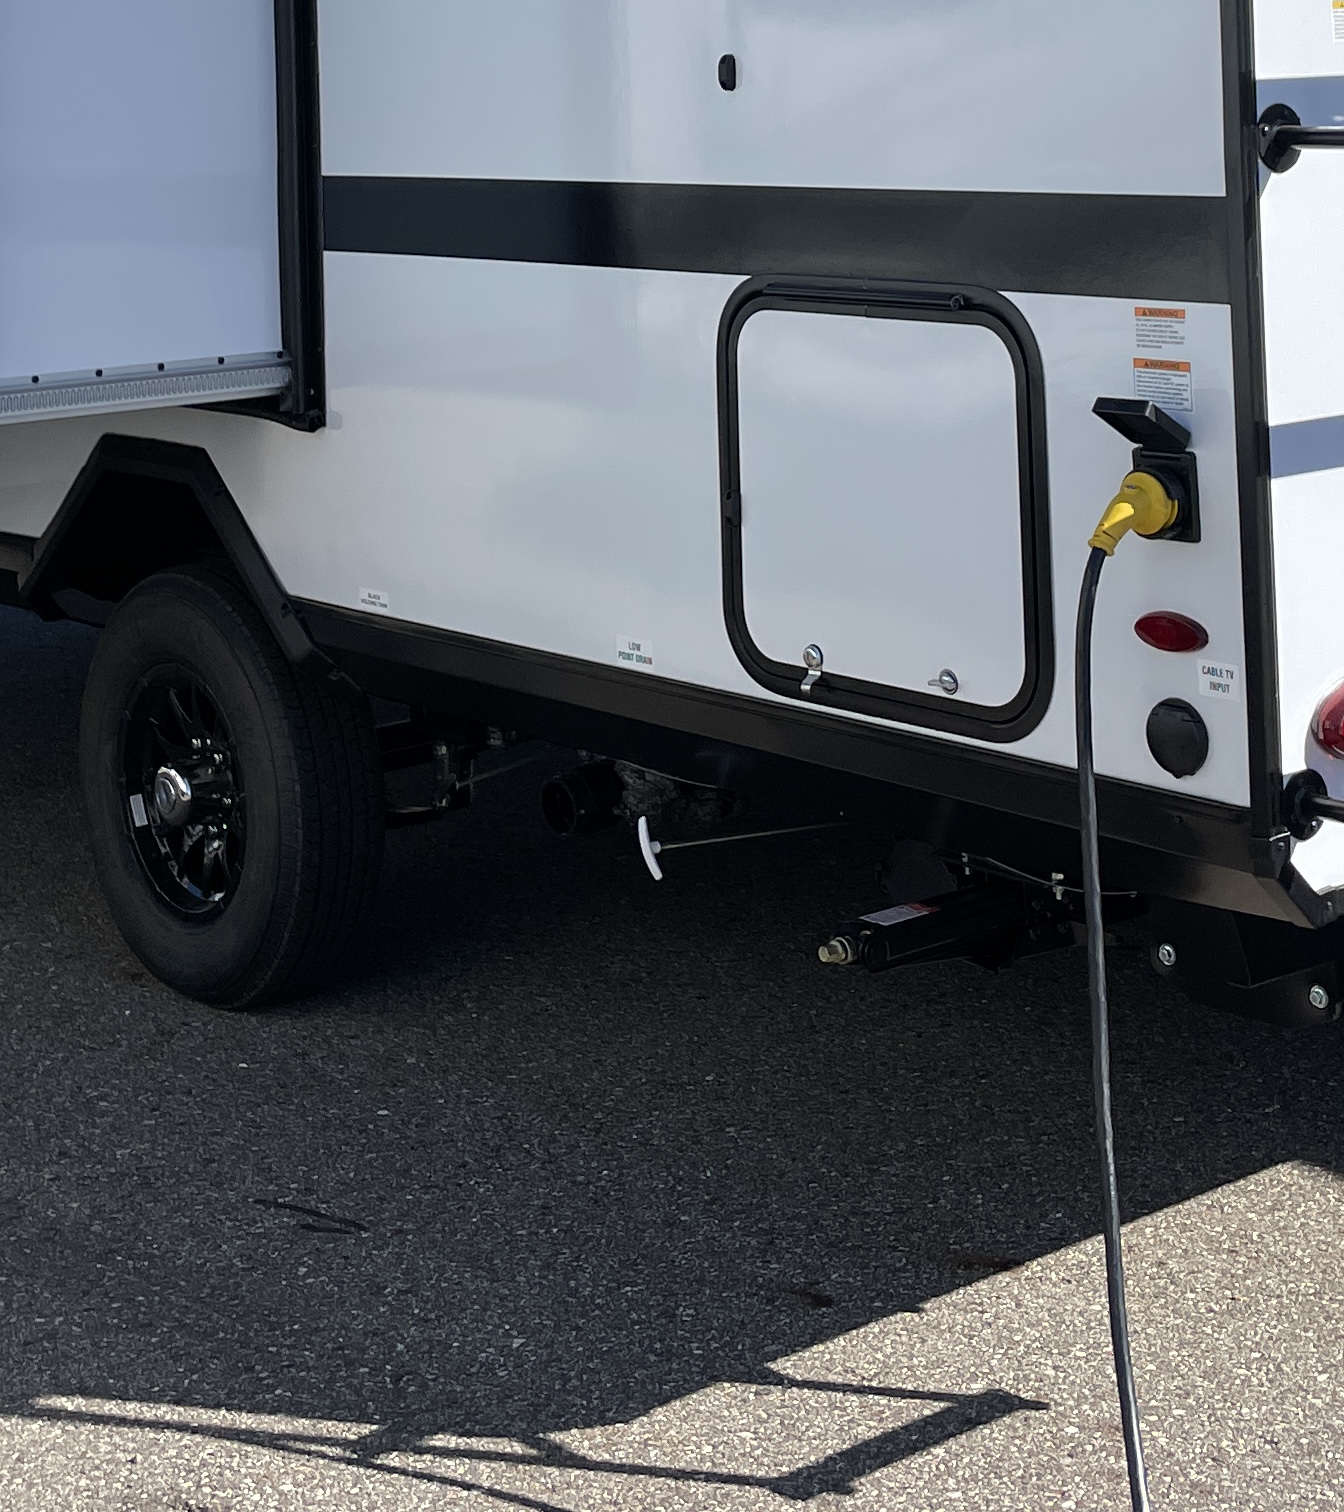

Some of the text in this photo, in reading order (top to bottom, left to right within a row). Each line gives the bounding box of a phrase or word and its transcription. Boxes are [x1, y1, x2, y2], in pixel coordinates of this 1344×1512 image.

[1202, 664, 1234, 679] CABLE TV
[1209, 680, 1231, 694] INPUT
